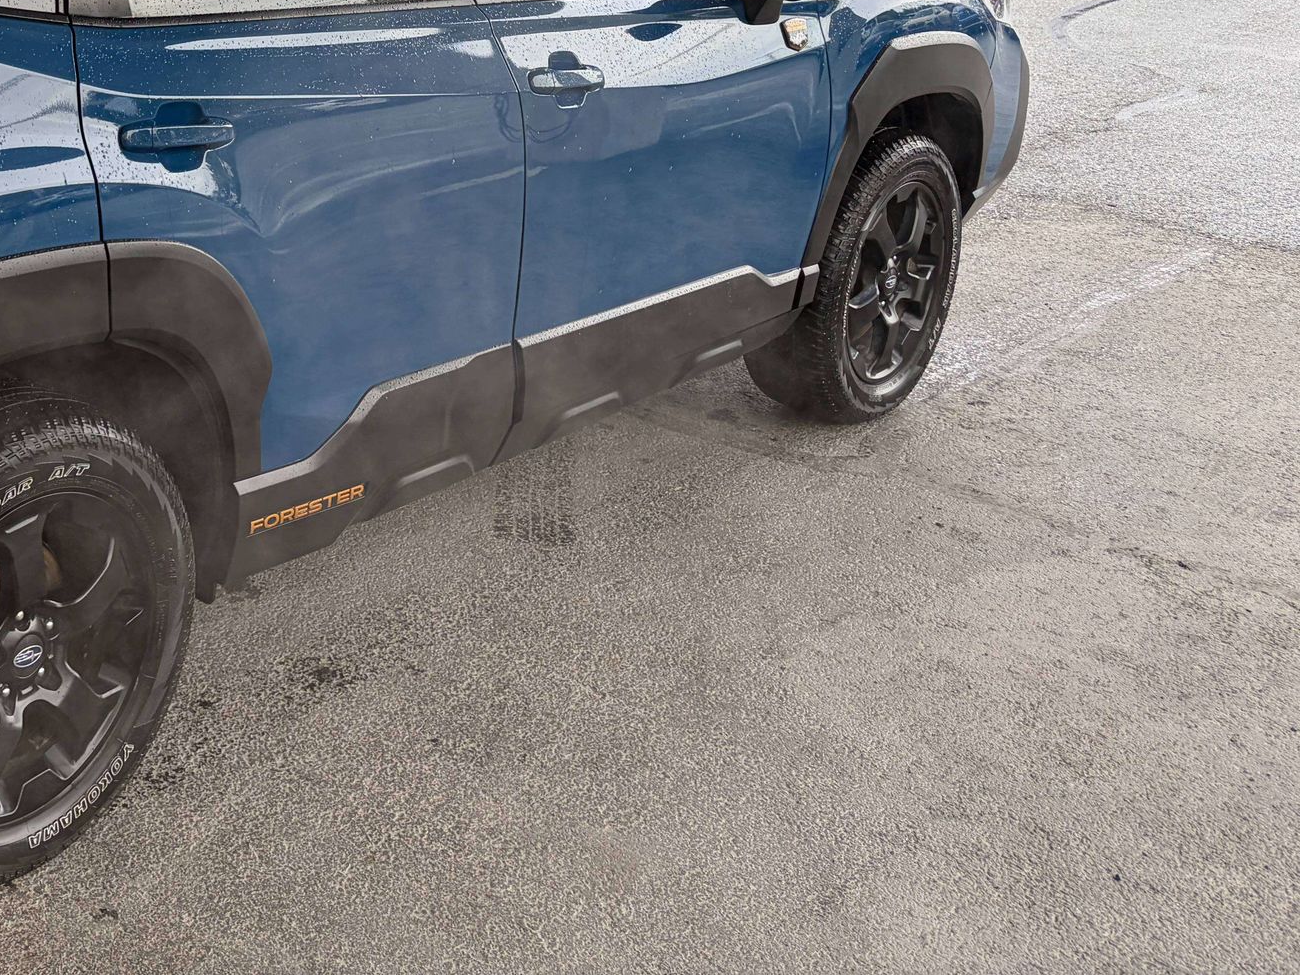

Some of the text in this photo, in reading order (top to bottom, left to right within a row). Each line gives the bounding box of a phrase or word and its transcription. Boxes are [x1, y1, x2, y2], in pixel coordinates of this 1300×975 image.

[47, 463, 90, 481] A/T
[249, 484, 365, 535] FORESTER
[28, 743, 135, 849] YOKOHAMA
